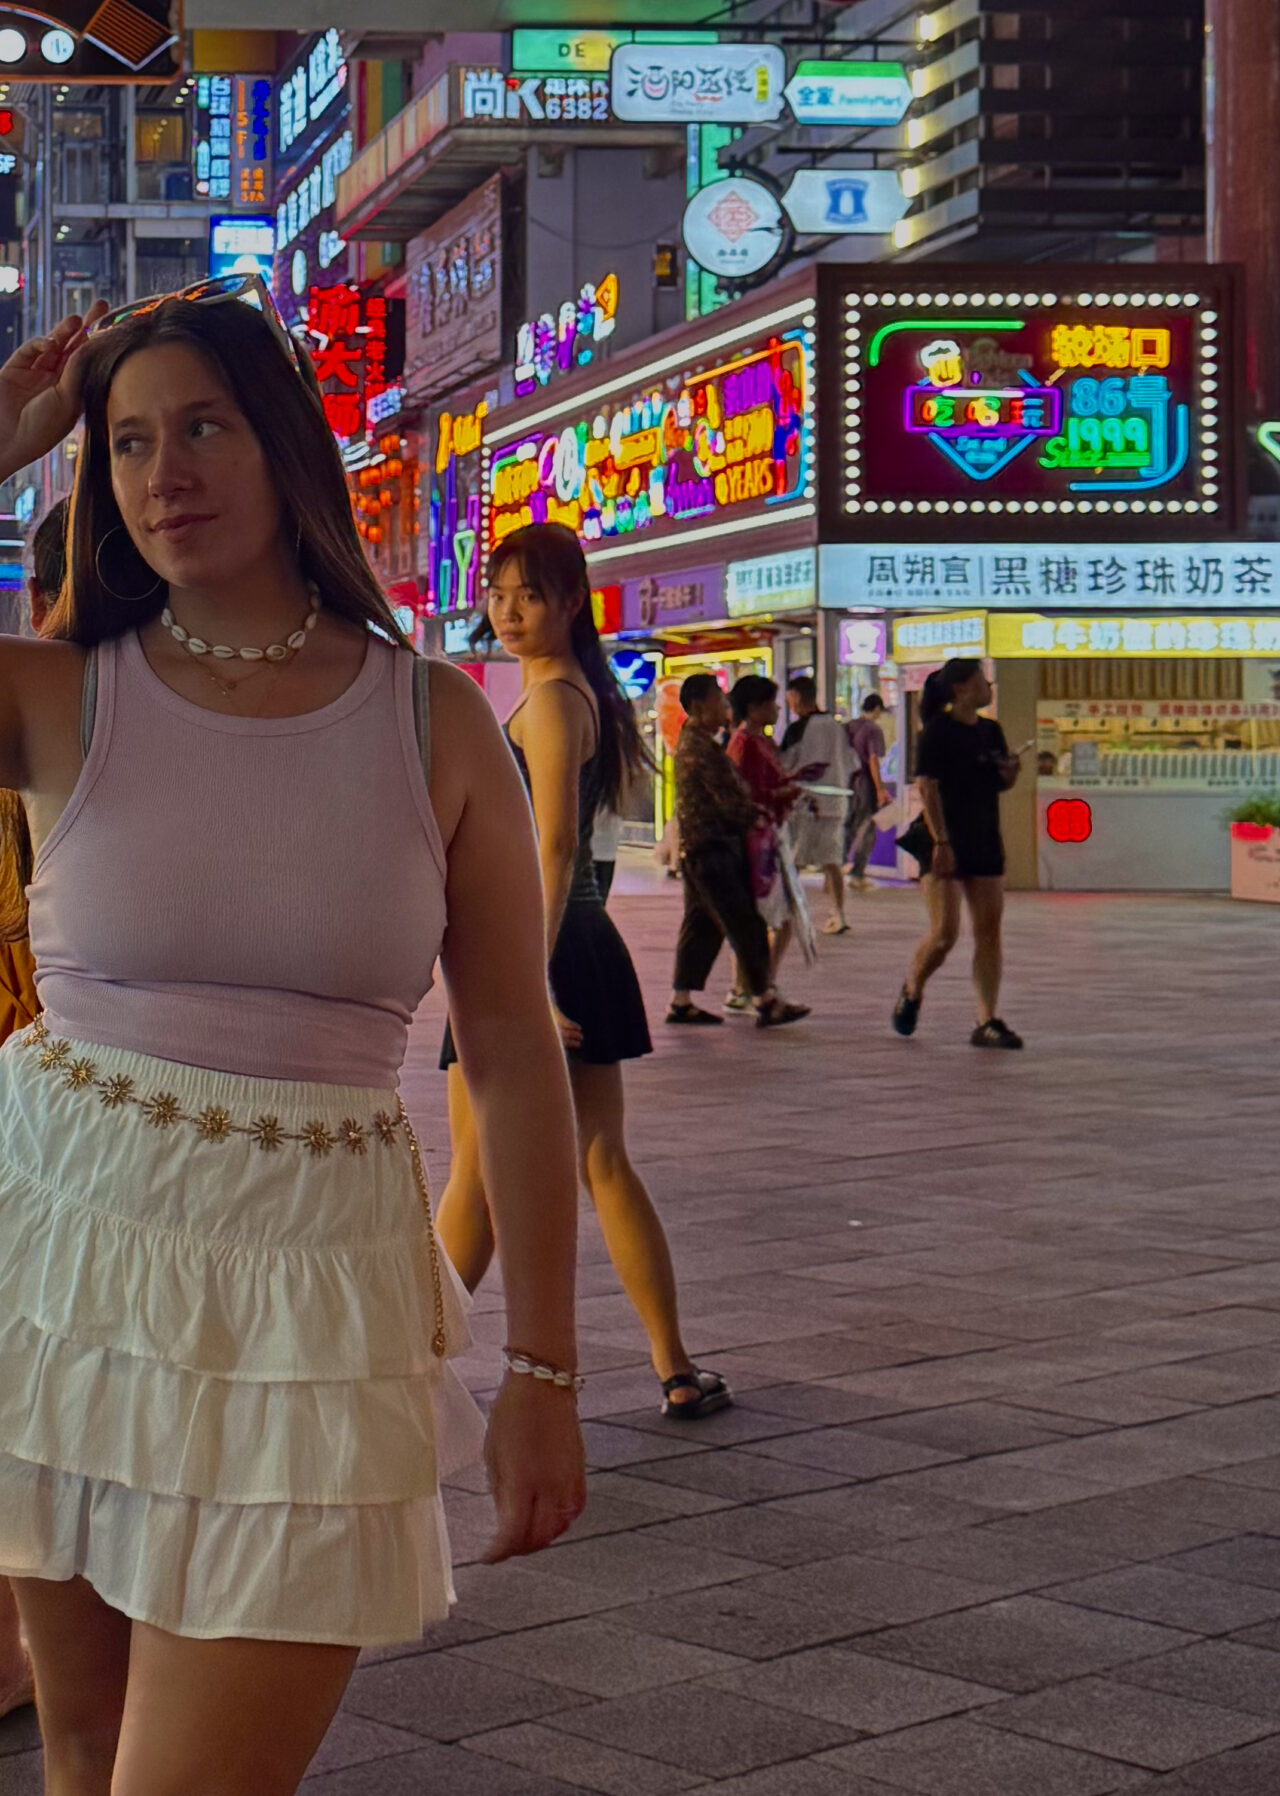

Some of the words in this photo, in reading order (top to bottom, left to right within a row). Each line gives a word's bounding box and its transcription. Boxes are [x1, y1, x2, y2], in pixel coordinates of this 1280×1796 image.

[558, 43, 585, 58] DE
[1067, 417, 1149, 453] 1999
[992, 555, 1273, 596] 黑糖珍珠奶茶
